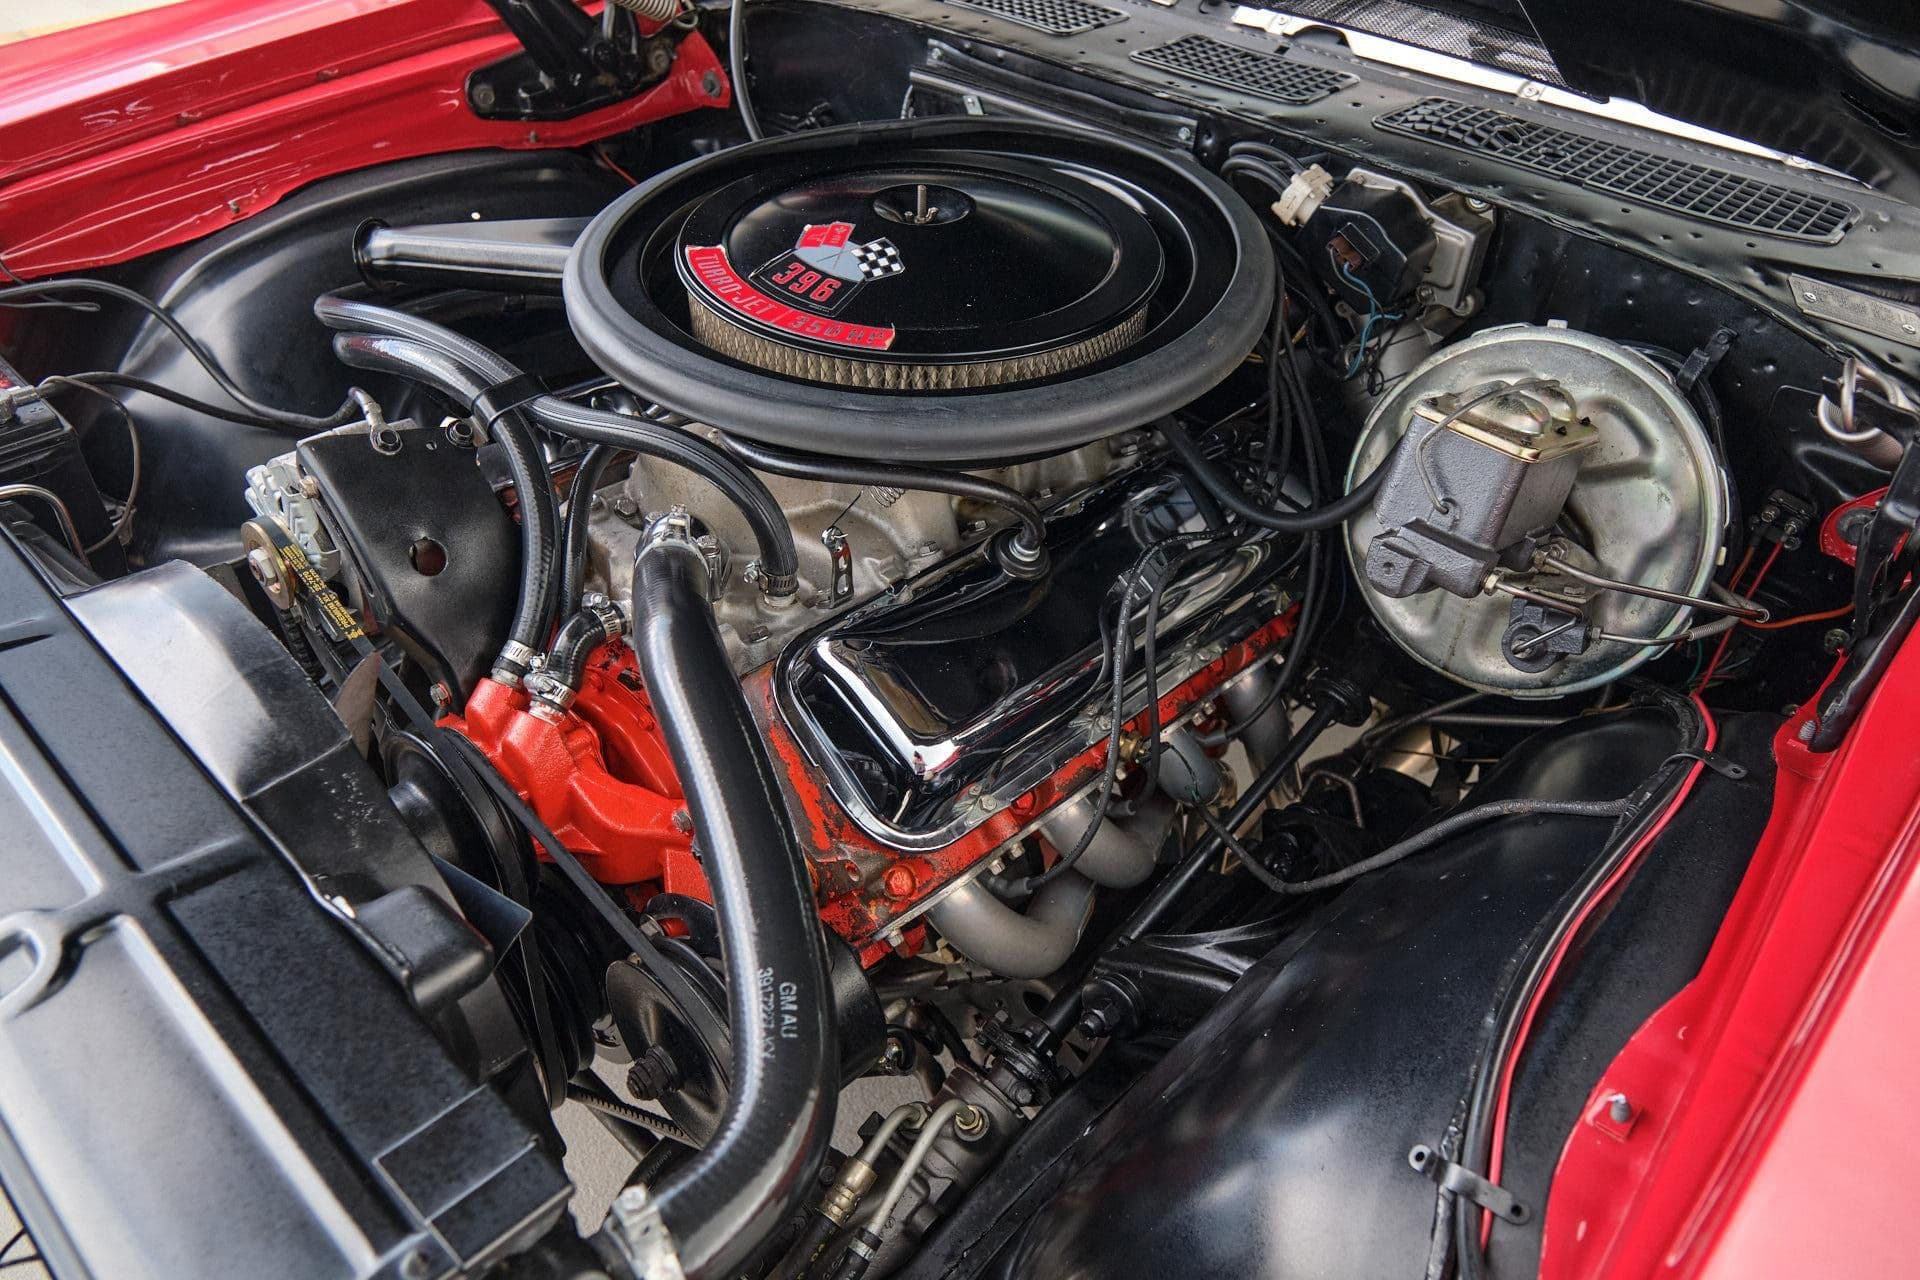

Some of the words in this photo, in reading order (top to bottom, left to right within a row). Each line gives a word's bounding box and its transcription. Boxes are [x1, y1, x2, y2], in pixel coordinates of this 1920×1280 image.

[694, 253, 778, 316] TURBO-JET
[790, 315, 842, 338] 350
[771, 261, 842, 302] 396
[779, 981, 798, 1011] GM
[780, 1013, 798, 1038] AU
